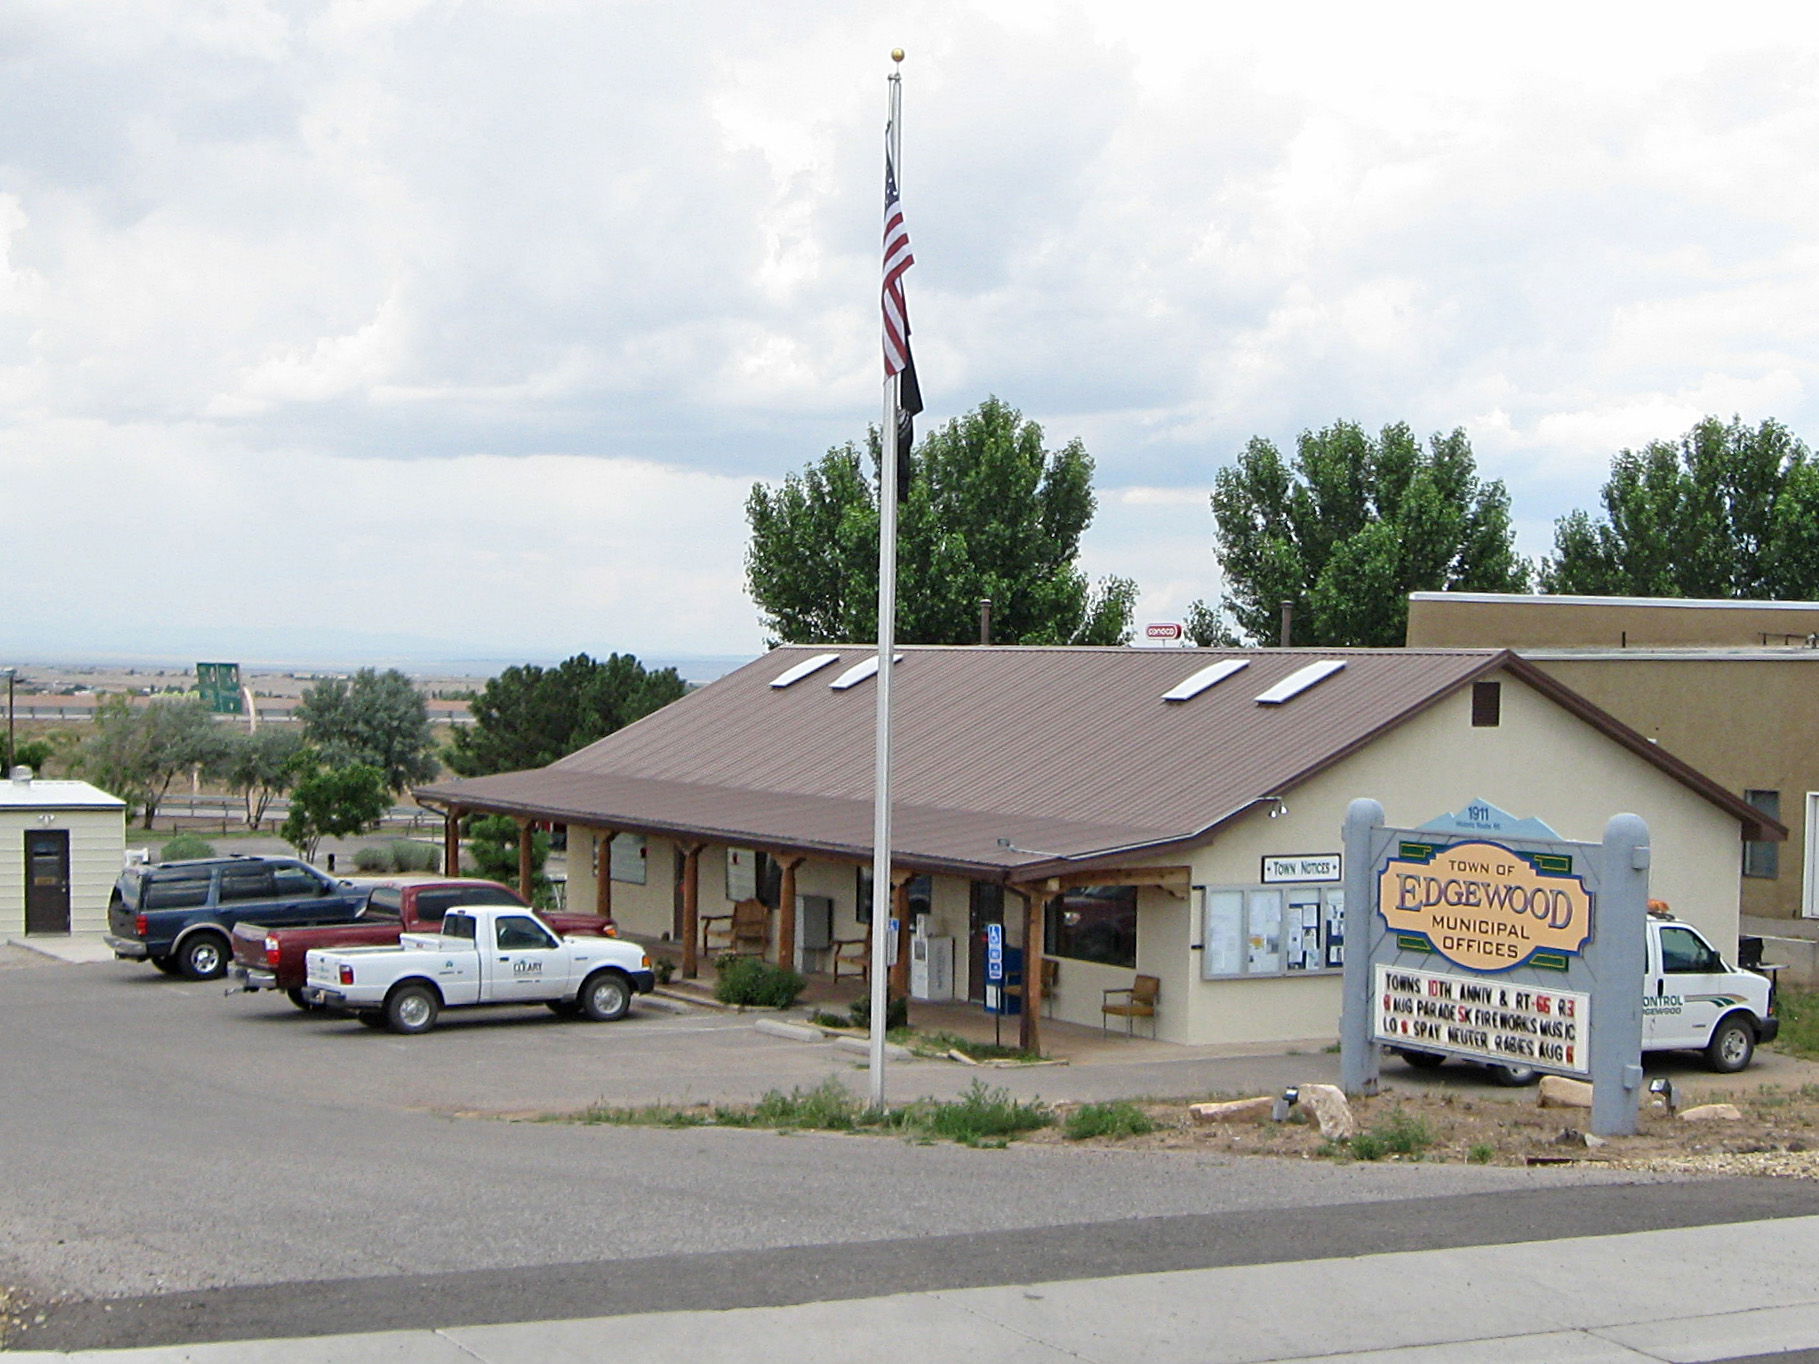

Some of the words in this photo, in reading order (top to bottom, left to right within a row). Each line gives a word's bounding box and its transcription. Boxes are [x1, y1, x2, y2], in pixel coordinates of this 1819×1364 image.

[1468, 806, 1489, 821] 1911
[1449, 860, 1490, 874] TOWN
[1496, 864, 1515, 876] OF
[1396, 873, 1573, 929] EDGEWOOD
[1432, 915, 1530, 940] MUNICIPAL
[1443, 936, 1518, 959] OFFICES
[1386, 973, 1421, 994] TOWNS
[1428, 979, 1452, 999] 10TH
[1460, 984, 1492, 1005] ANNIV
[1499, 990, 1508, 1008] &
[1642, 995, 1683, 1007] ONTROL
[1393, 998, 1413, 1015] AUG
[1417, 1000, 1456, 1022] PARADE
[1475, 1009, 1537, 1035] FIREWORKS
[1540, 1019, 1576, 1041] MUSIC
[1413, 1021, 1441, 1040] SPAY
[1448, 1026, 1488, 1050] NEUTER
[1495, 1035, 1534, 1057] RABIES
[1539, 1041, 1563, 1061] AUG
